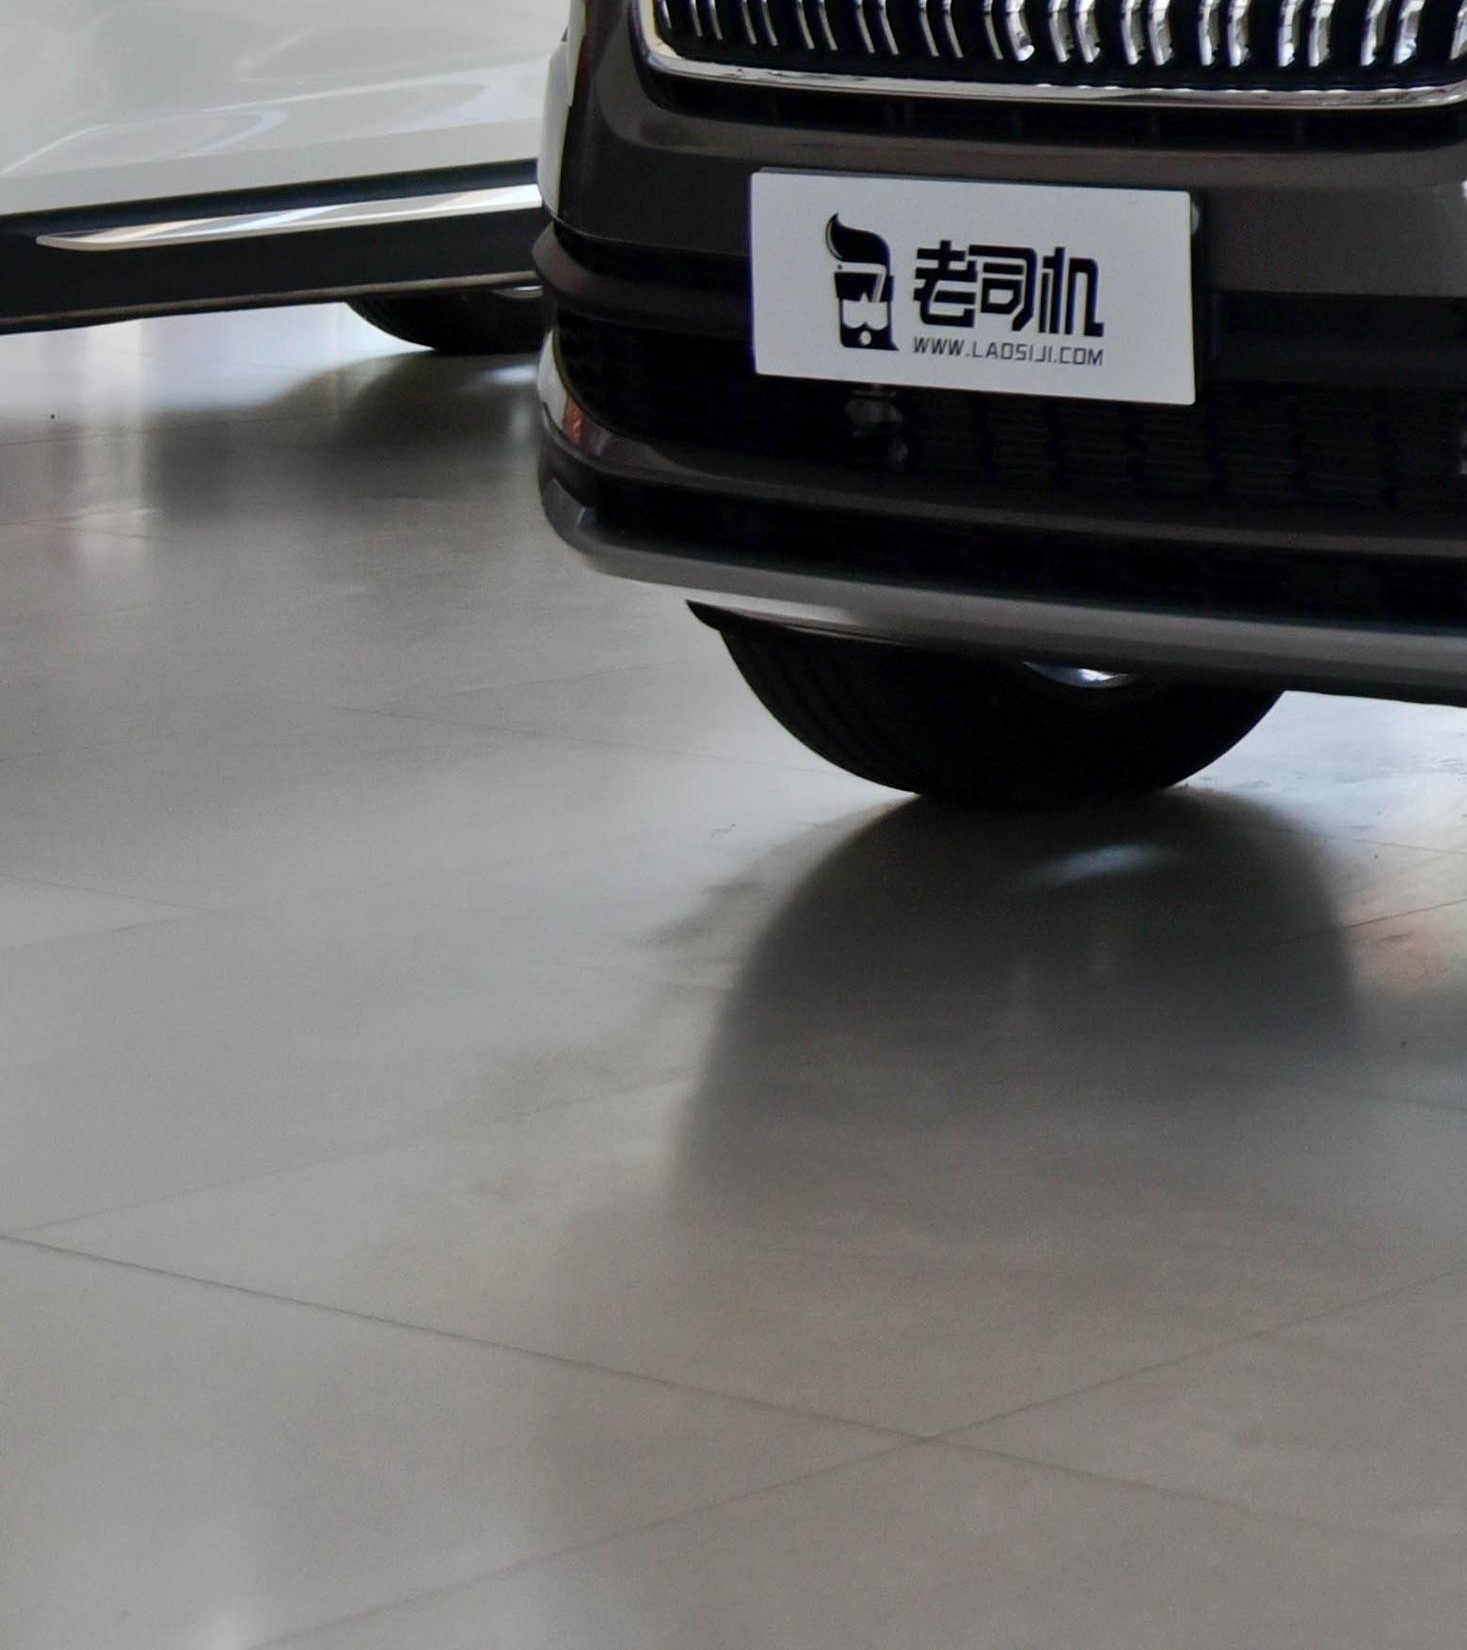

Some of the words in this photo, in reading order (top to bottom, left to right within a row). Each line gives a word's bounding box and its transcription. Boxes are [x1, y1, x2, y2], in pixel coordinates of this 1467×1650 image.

[914, 240, 1104, 337] 老司机
[914, 336, 1104, 366] WWW.LAOSIJI.COM
